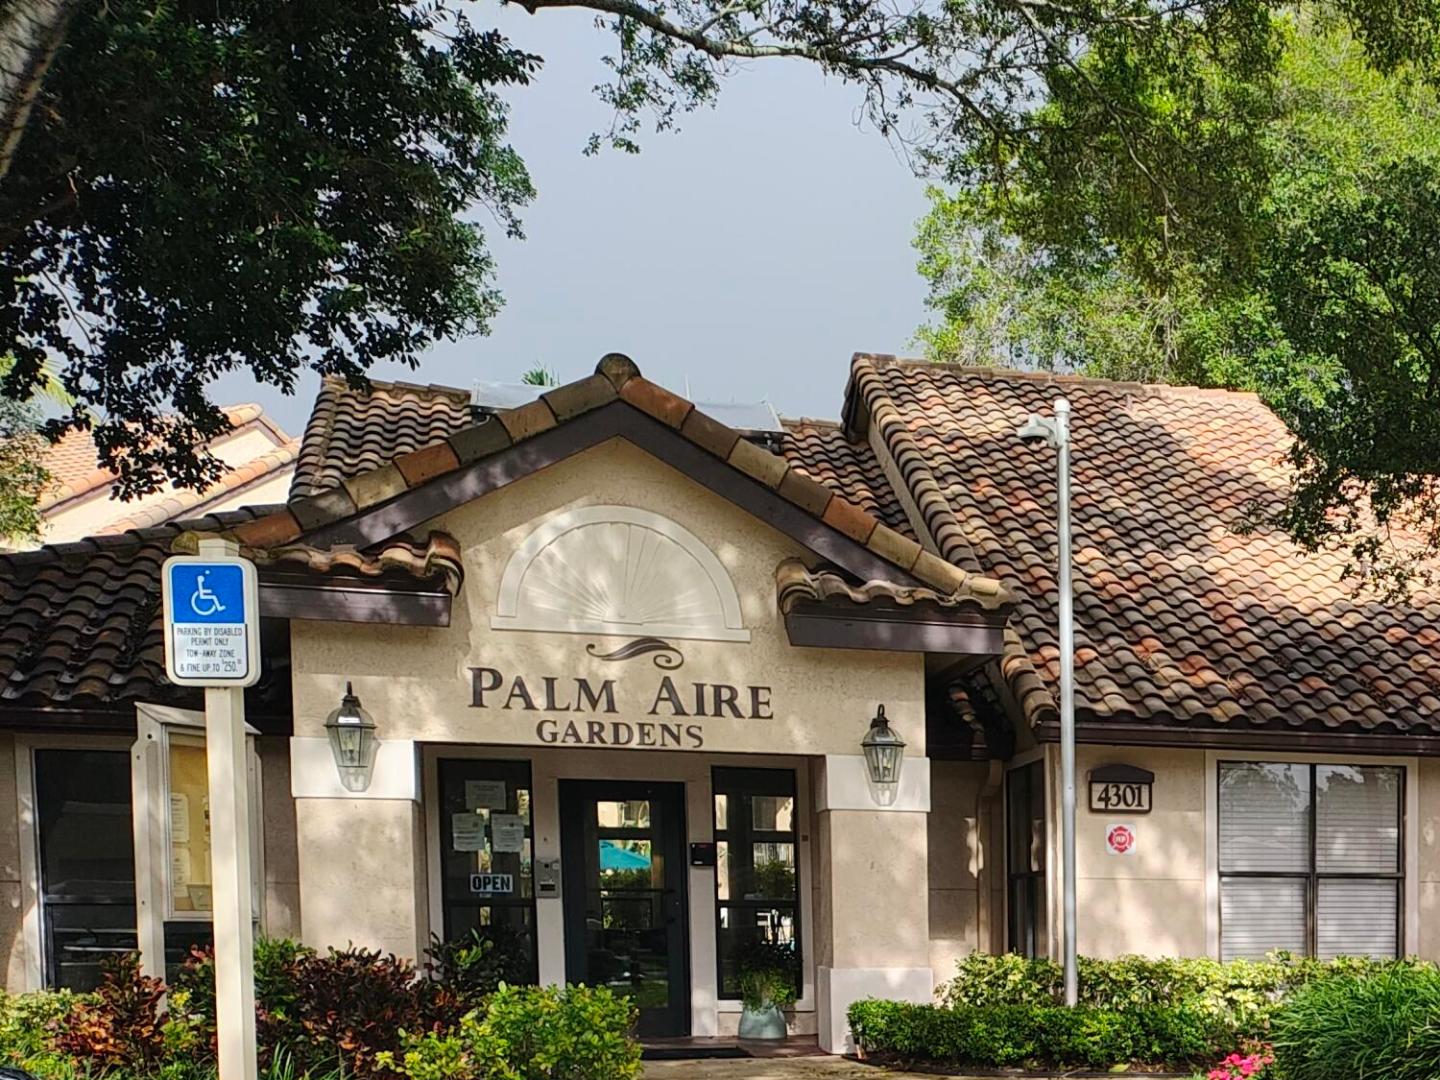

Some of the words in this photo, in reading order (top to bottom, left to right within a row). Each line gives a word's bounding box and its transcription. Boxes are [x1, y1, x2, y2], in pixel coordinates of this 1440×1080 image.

[177, 628, 202, 636] PARKING
[204, 628, 211, 636] BY
[214, 628, 242, 636] DISABLED
[191, 637, 212, 646] PERMIT
[214, 638, 229, 646] ONLY
[186, 649, 217, 658] TOW-AWAY
[219, 649, 235, 658] ZONE
[187, 663, 201, 672] FINE
[203, 663, 210, 672] UP
[213, 663, 220, 672] TO
[467, 667, 619, 713] PALM
[647, 676, 774, 720] AIRE
[536, 720, 704, 748] GARDENS
[1097, 784, 1144, 809] 4301
[472, 875, 511, 890] OPEN
